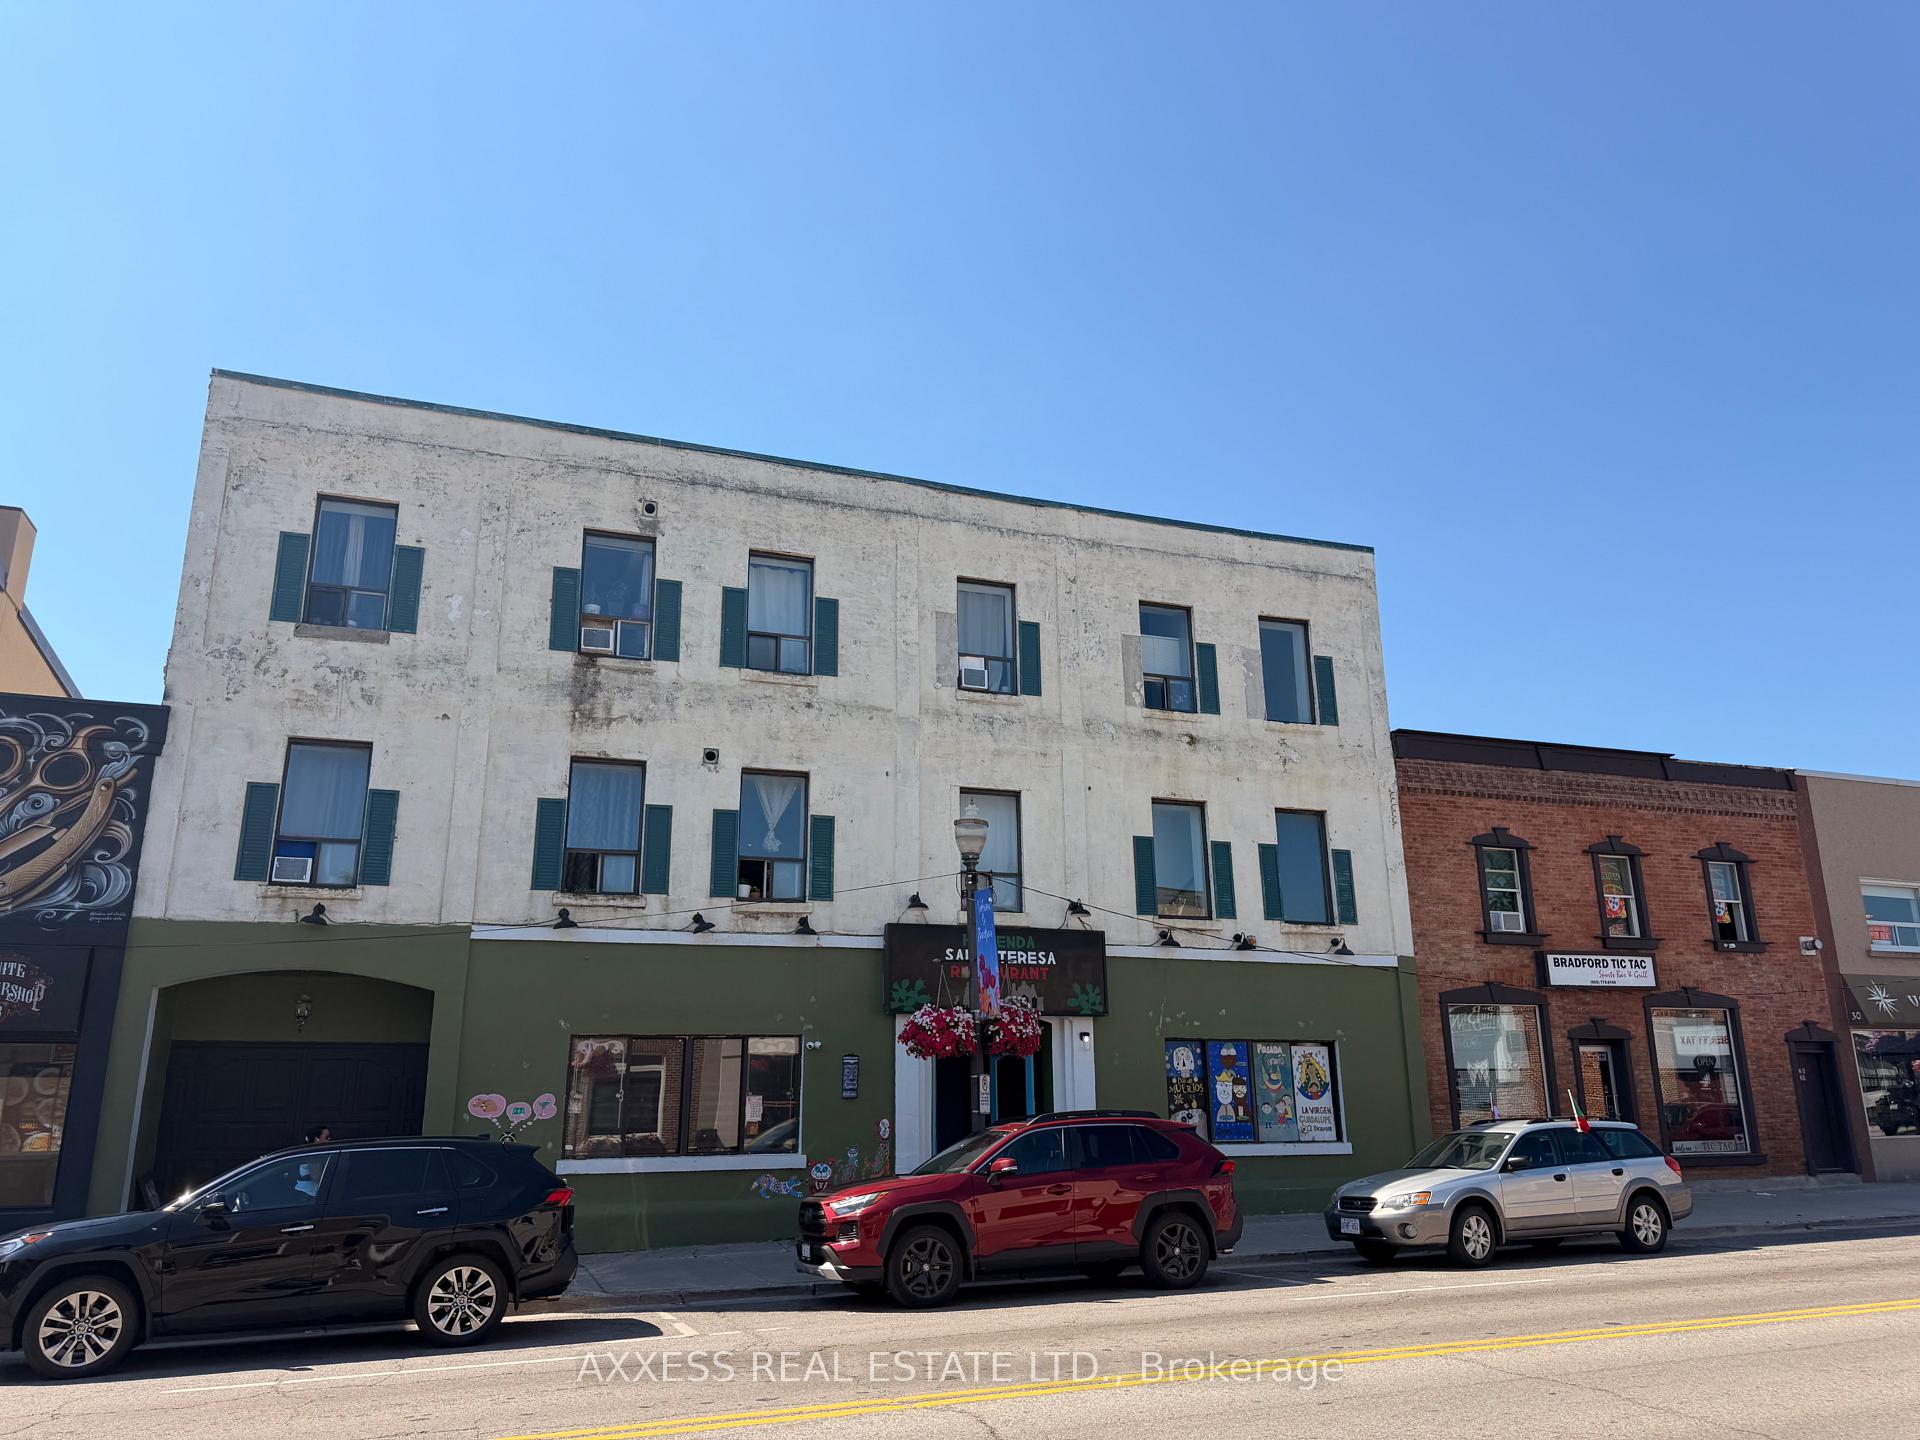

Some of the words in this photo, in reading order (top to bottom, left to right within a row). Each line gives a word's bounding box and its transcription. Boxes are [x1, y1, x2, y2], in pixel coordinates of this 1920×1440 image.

[997, 950, 1057, 965] TERESA
[1553, 957, 1609, 969] BRADFORD
[1611, 958, 1626, 969] TIC
[1628, 959, 1647, 970] TAC
[1634, 970, 1649, 979] Grill
[1851, 1012, 1862, 1021] 30
[1696, 1057, 1714, 1067] OPEN
[1302, 1106, 1309, 1114] LA
[1309, 1106, 1332, 1115] VIRGEN
